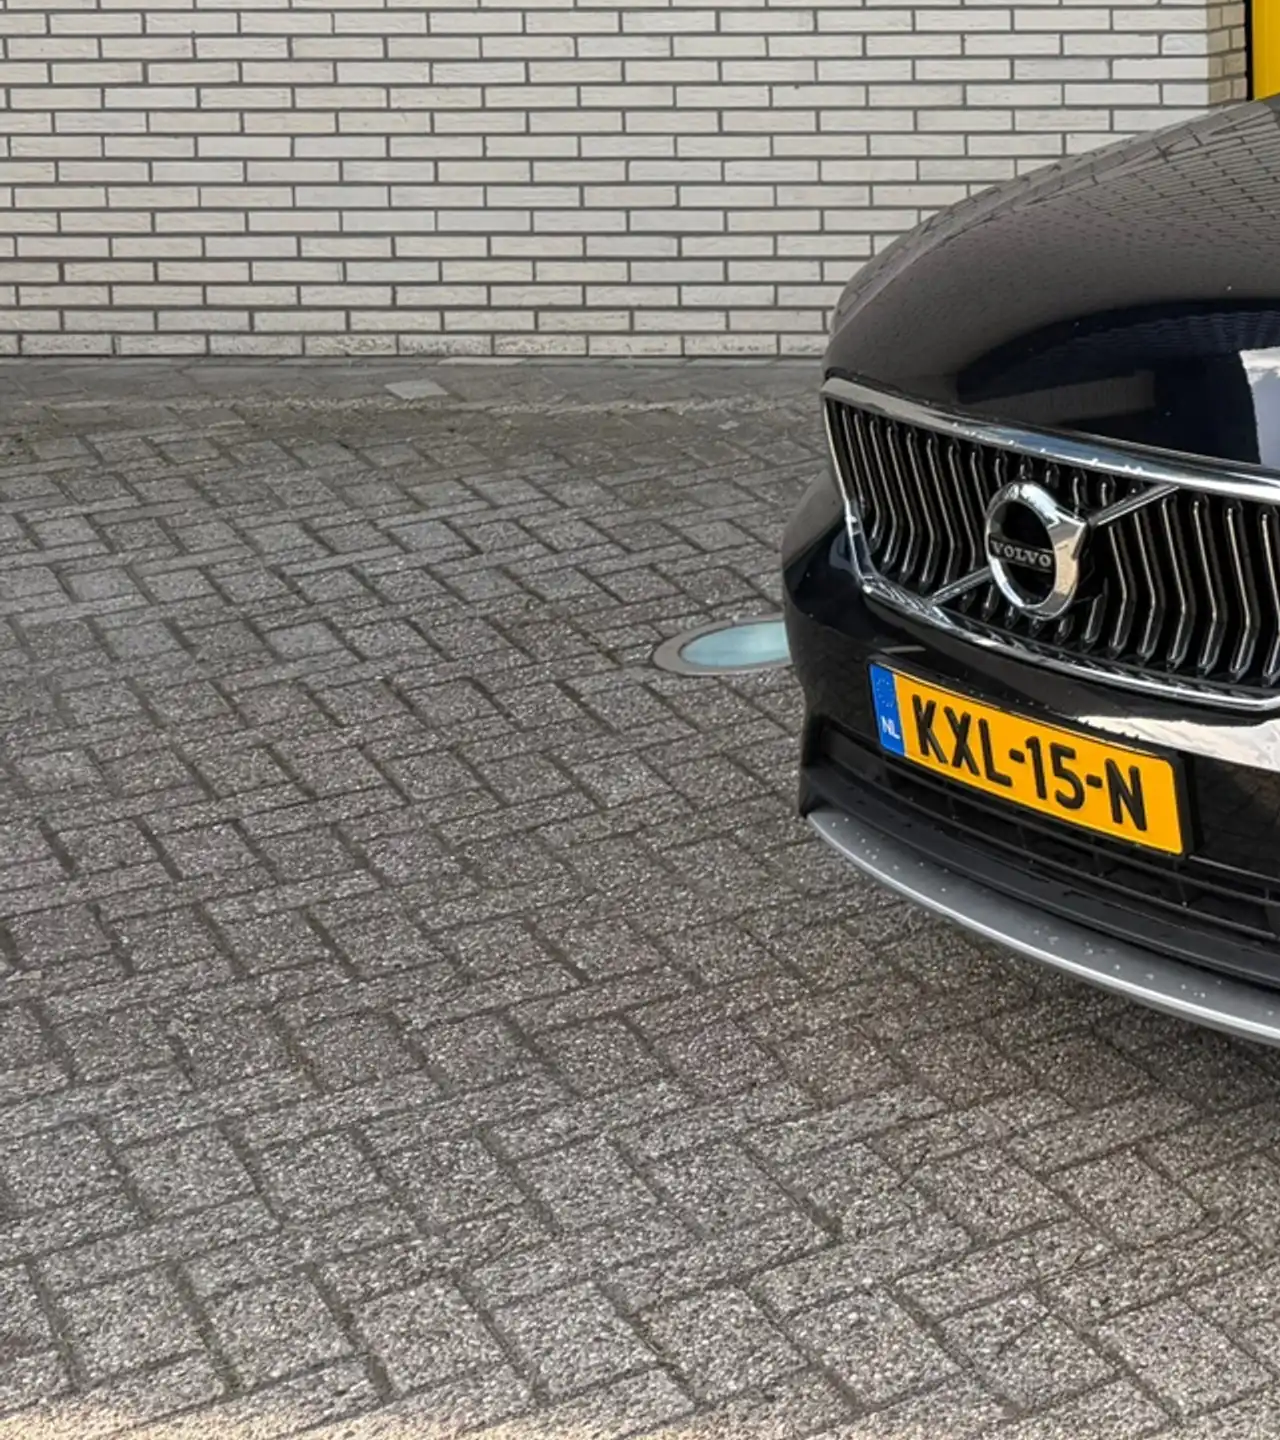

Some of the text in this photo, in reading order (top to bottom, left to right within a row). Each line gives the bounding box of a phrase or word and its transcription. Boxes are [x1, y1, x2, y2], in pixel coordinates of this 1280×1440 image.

[990, 540, 1052, 568] VOLVO
[881, 716, 901, 740] NL
[912, 694, 1148, 832] KXL-15-N
